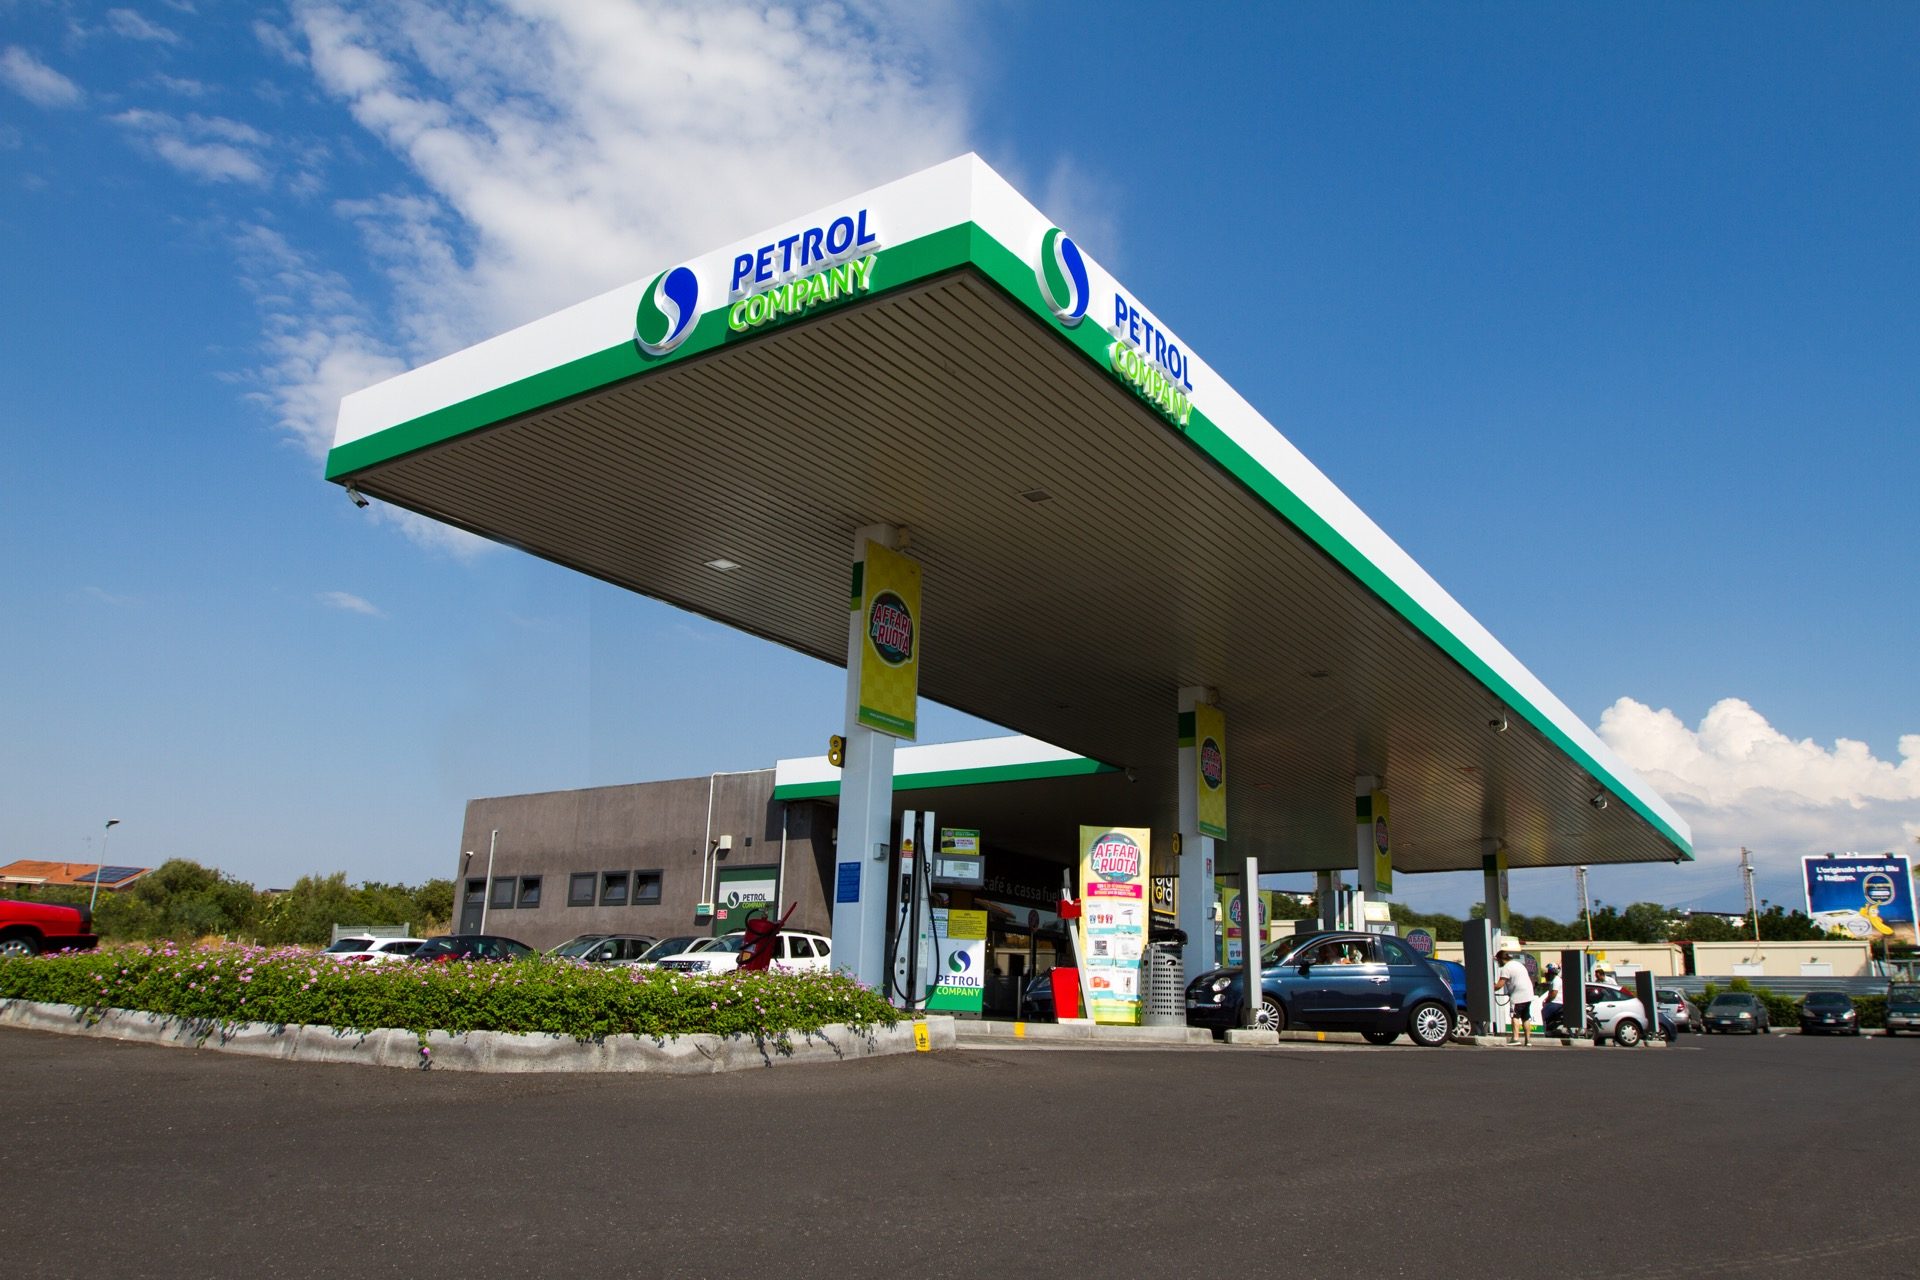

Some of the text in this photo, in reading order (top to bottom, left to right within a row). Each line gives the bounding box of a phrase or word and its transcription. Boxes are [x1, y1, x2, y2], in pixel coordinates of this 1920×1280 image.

[731, 209, 876, 291] PETROL
[728, 255, 878, 332] COMPANY
[1115, 292, 1193, 392] PETROL
[1110, 341, 1193, 426] COMPANY
[873, 604, 911, 636] AFFARI
[877, 624, 910, 656] RUOTA
[828, 735, 842, 767] 8
[1093, 843, 1139, 860] AFFARI
[1099, 858, 1138, 876] RUOTA
[742, 893, 767, 902] PETROL
[1014, 884, 1041, 900] cassa
[936, 986, 981, 997] COMPANY
[937, 974, 981, 987] PETROL
